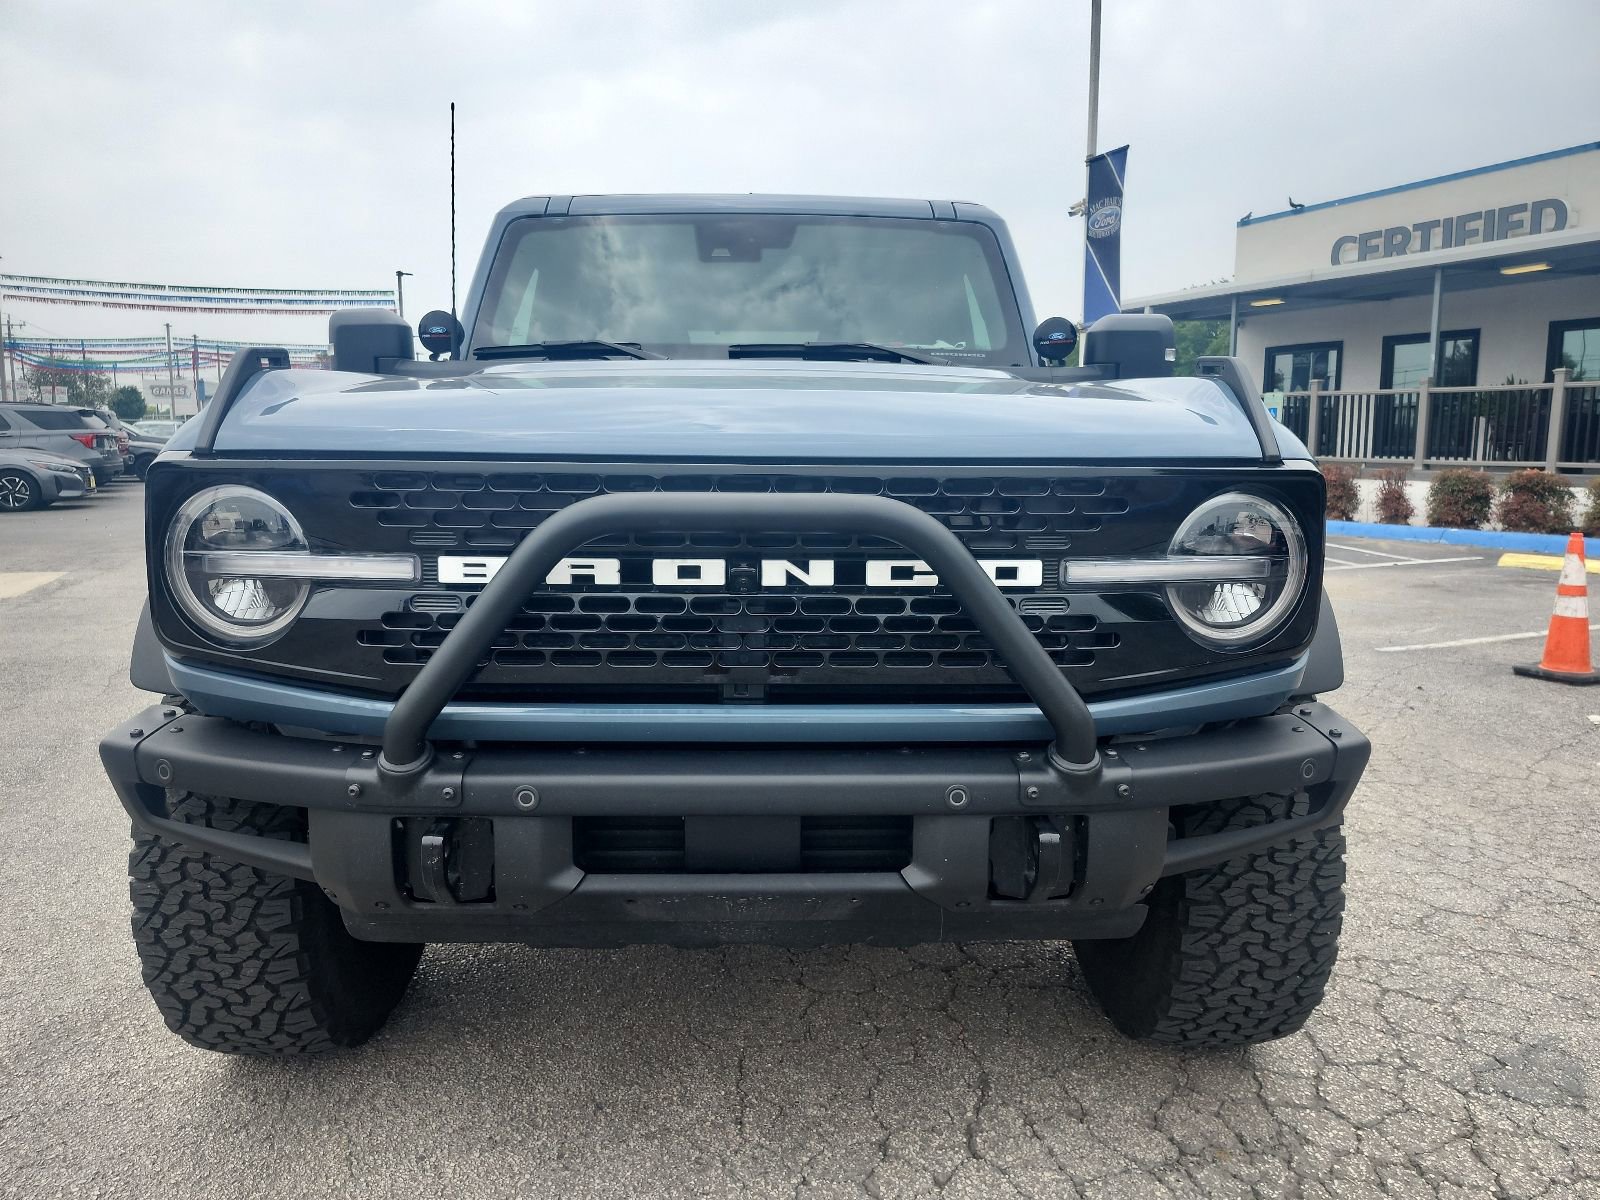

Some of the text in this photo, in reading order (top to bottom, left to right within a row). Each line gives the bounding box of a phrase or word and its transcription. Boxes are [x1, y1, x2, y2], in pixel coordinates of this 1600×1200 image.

[1093, 210, 1117, 229] Ford
[1331, 198, 1568, 266] CERTIFIED
[437, 555, 1043, 586] BRONCO
